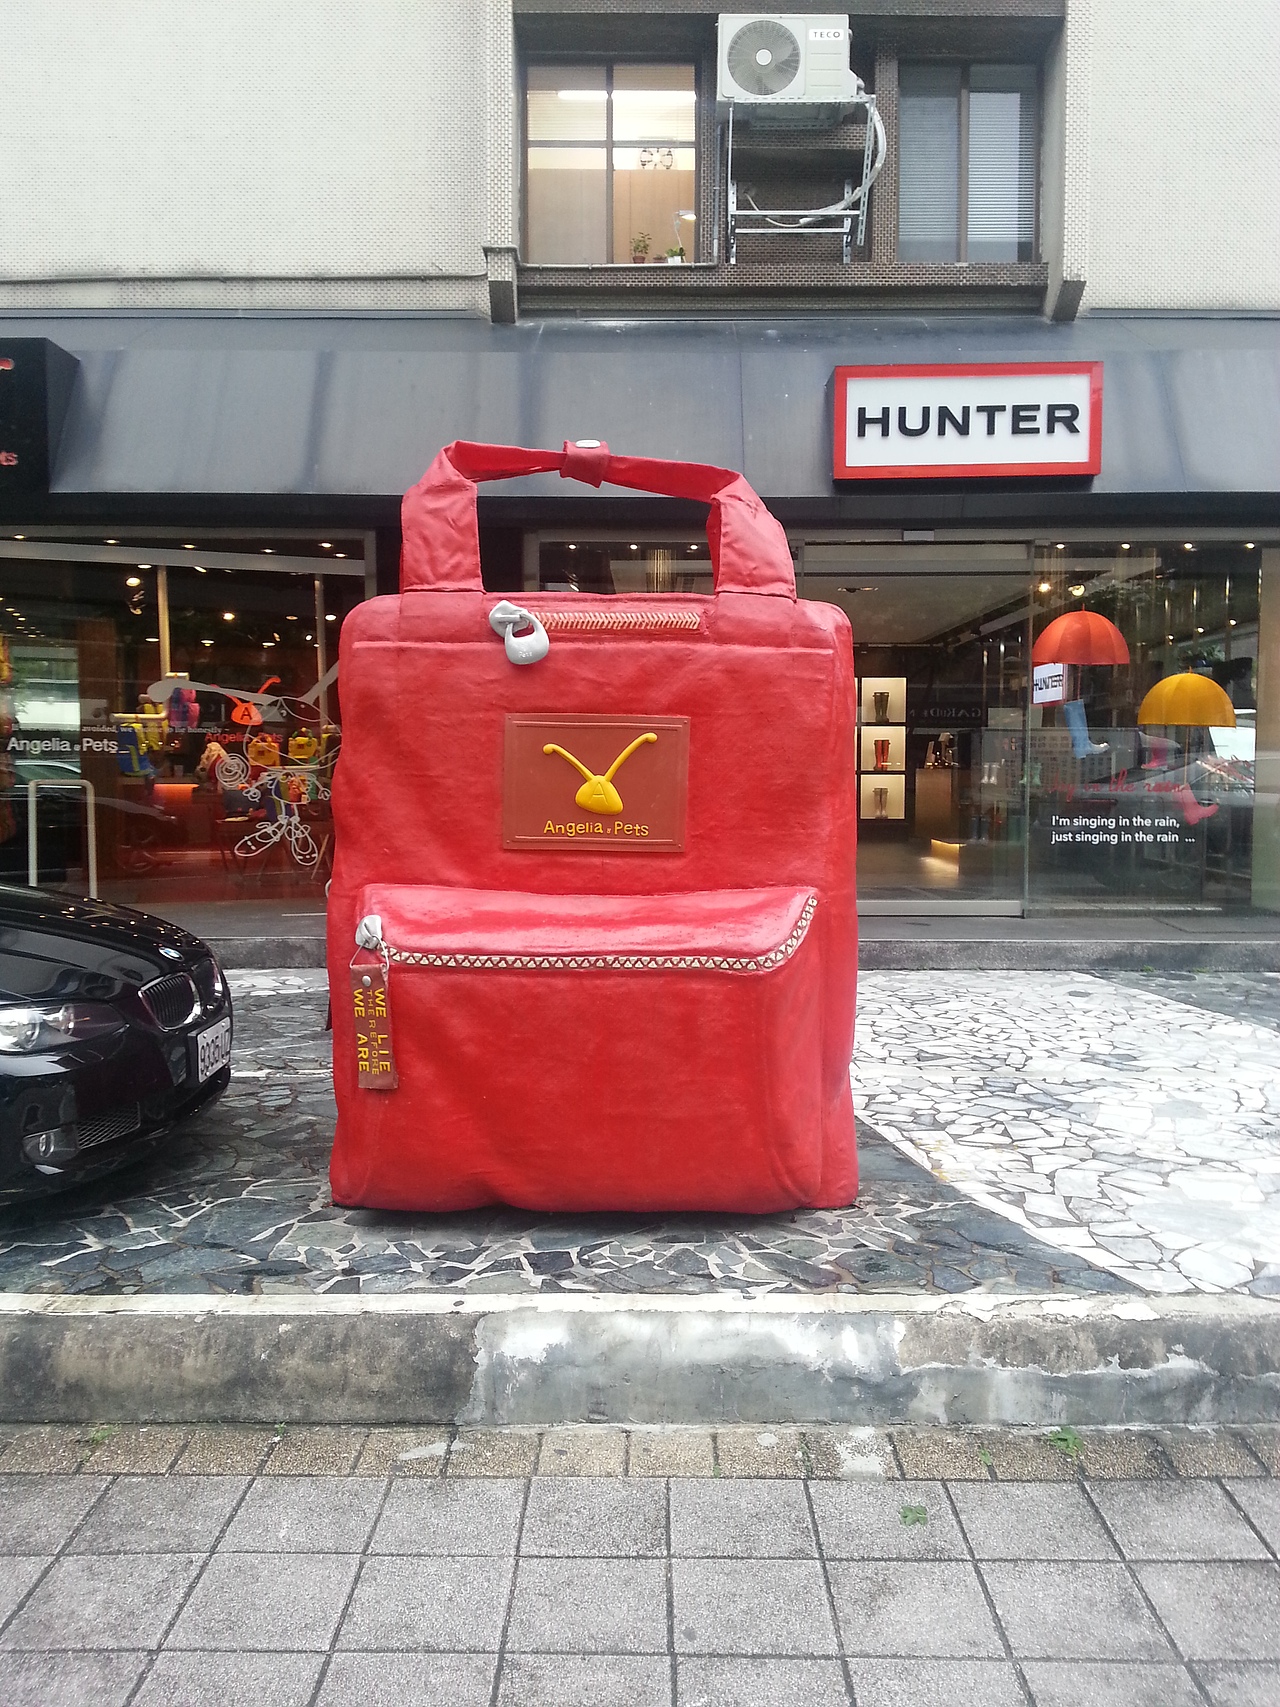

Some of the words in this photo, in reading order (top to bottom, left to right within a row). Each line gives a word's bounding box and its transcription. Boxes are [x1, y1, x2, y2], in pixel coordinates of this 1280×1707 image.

[857, 403, 1081, 437] HUNTER
[6, 737, 72, 754] Angelia
[82, 737, 119, 752] Pets
[543, 820, 604, 837] Angelia
[614, 821, 650, 837] Pets
[1051, 815, 1070, 826] I'm
[1073, 816, 1116, 828] singing
[1119, 816, 1130, 826] in
[1132, 816, 1152, 826] the
[1154, 816, 1180, 828] rain,
[1051, 832, 1073, 844] just
[1075, 832, 1119, 844] singing
[1121, 832, 1131, 842] in
[1134, 832, 1154, 842] the
[1156, 832, 1179, 842] rain
[353, 988, 365, 1018] WE
[374, 988, 387, 1017] WE
[357, 1033, 370, 1072] ARE
[377, 1034, 391, 1072] LIE
